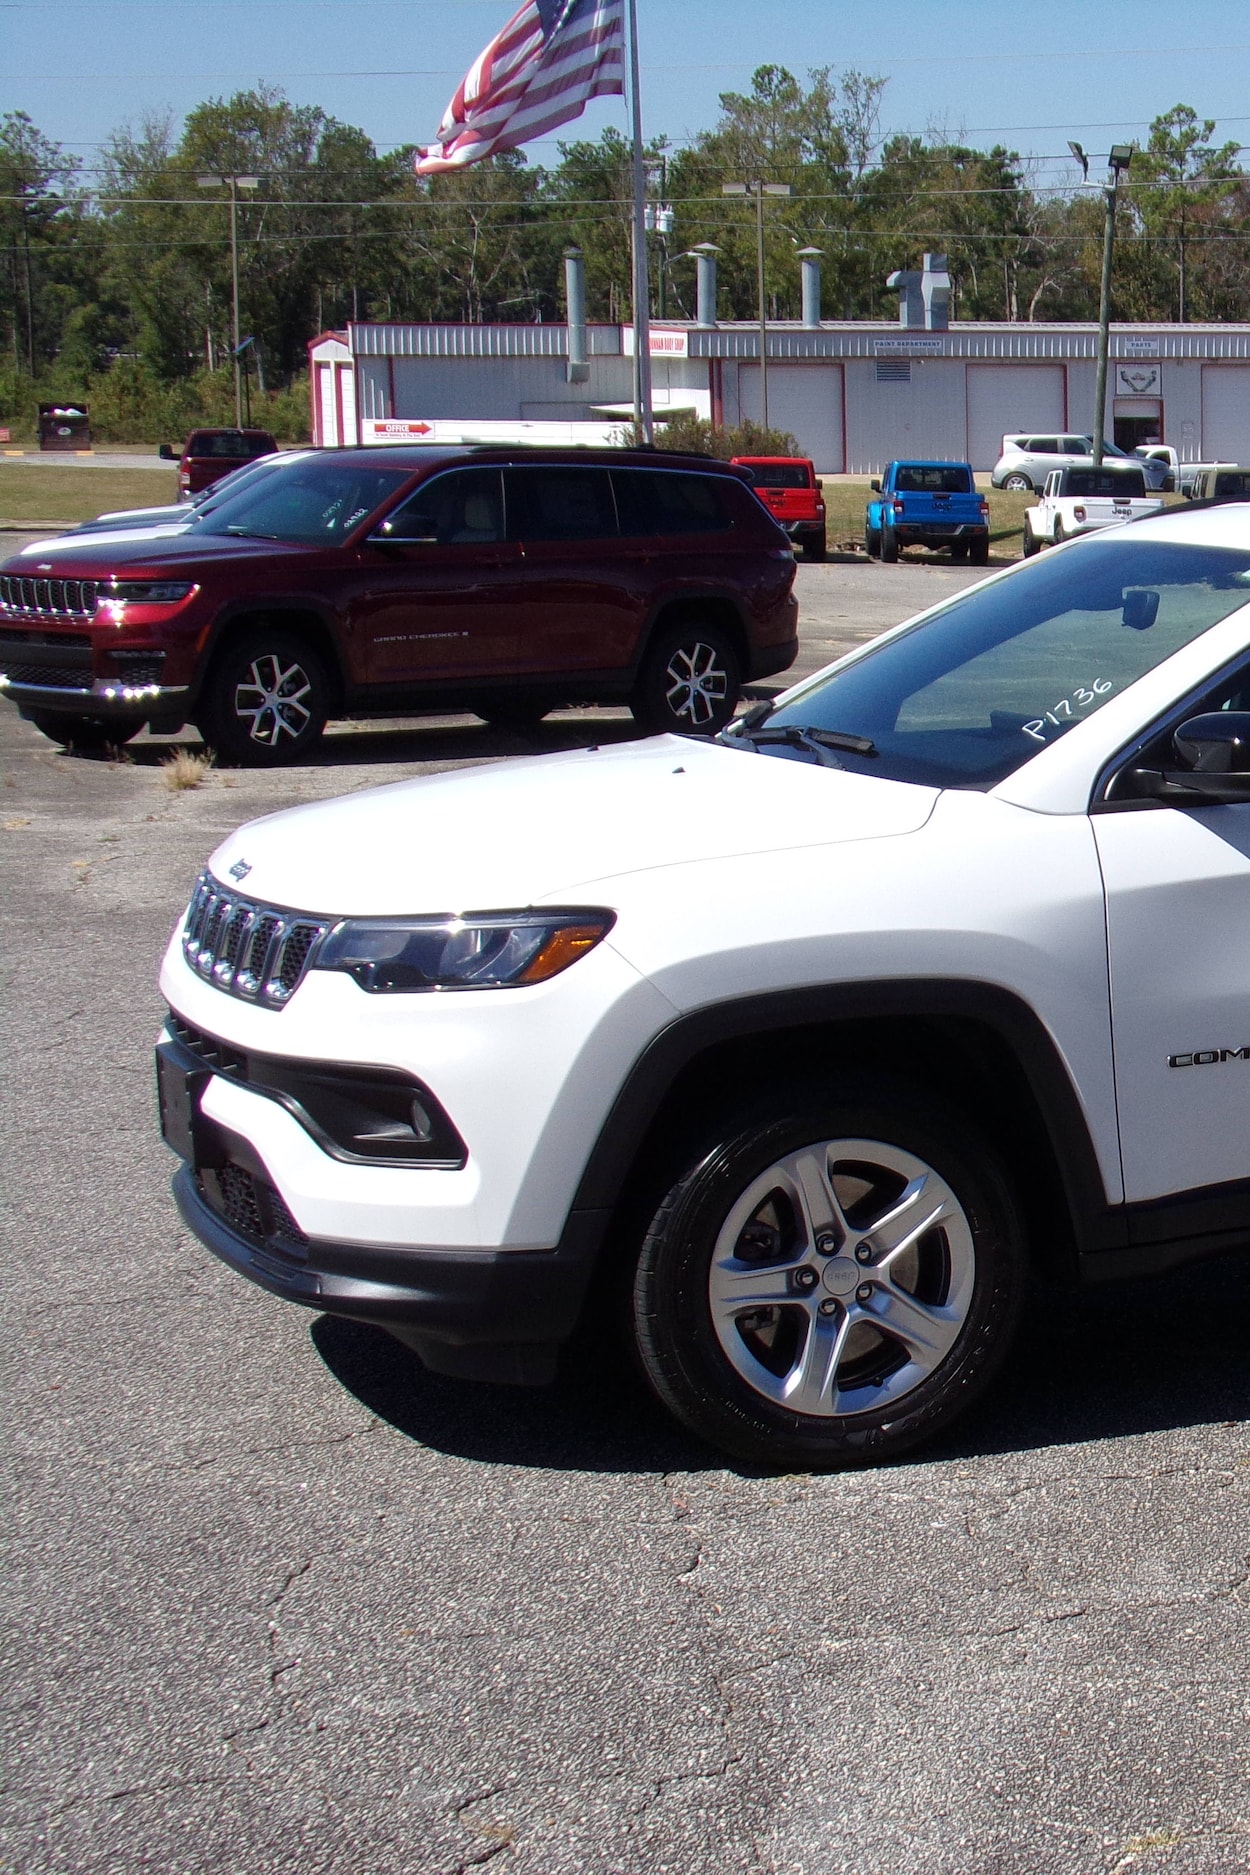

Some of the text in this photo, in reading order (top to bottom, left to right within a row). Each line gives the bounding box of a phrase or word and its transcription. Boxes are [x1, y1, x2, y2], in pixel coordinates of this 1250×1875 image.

[386, 424, 410, 432] OFFICE
[1112, 505, 1132, 517] Jeep
[1022, 678, 1113, 740] P1736
